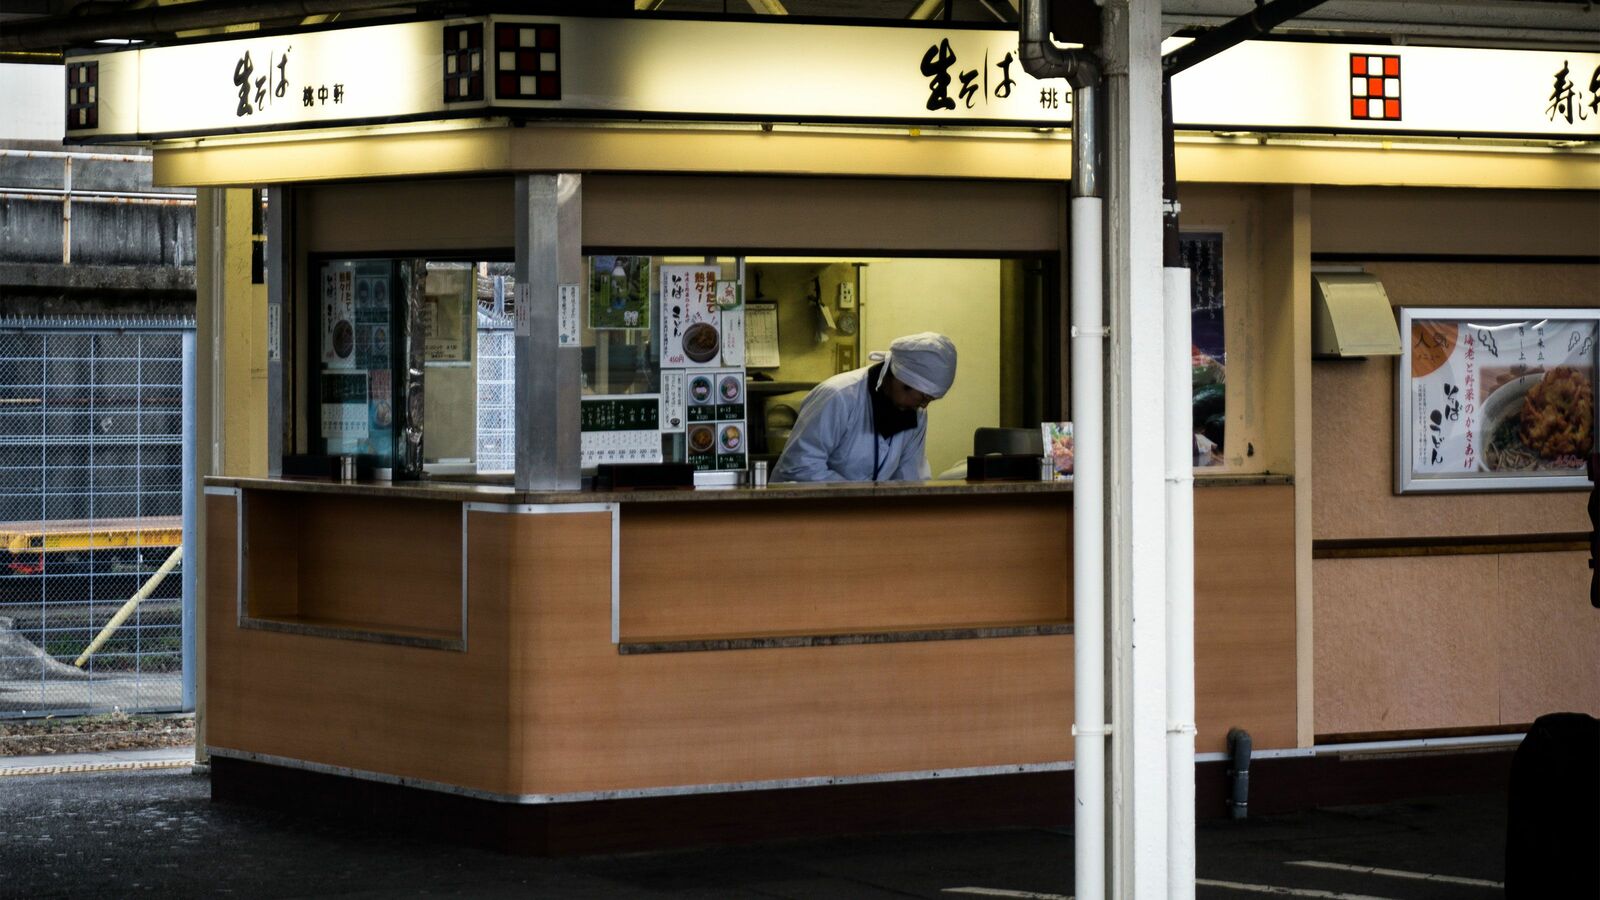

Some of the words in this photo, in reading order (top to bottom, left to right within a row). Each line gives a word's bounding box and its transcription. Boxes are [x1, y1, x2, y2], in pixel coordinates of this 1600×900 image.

[302, 83, 344, 107] 桃中軒
[1444, 382, 1463, 422] そば
[1463, 333, 1476, 469] 海老と野菜のかきあげ
[1429, 409, 1446, 466] うどん
